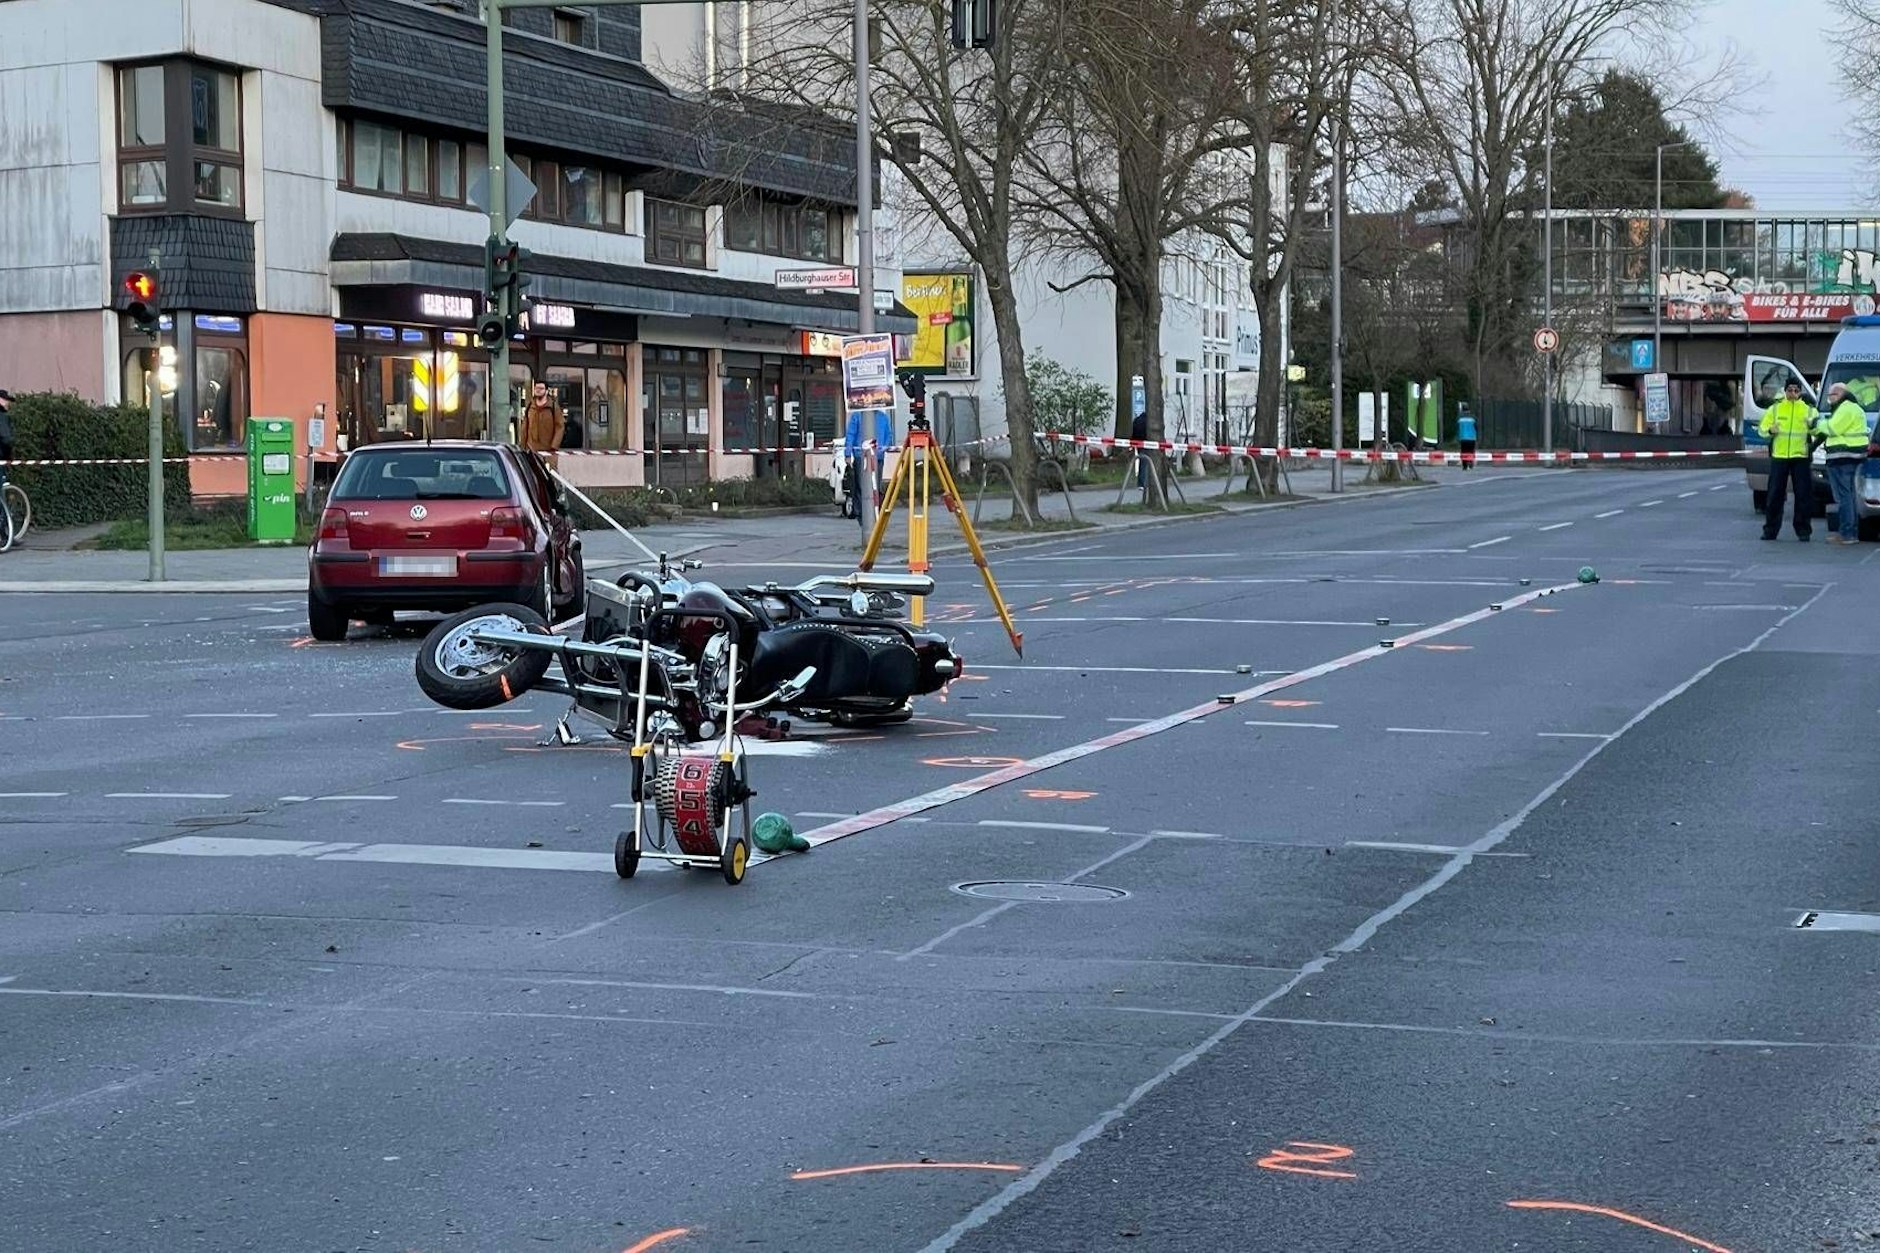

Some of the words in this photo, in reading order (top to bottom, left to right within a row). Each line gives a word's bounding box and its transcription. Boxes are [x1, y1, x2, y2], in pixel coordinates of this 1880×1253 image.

[779, 271, 837, 285] Hildburghauser
[1751, 295, 1787, 306] BIKES
[1788, 296, 1799, 306] &
[1802, 295, 1850, 306] E-BIKES
[1773, 306, 1798, 318] FÜR
[1800, 307, 1829, 318] ALLE
[272, 492, 290, 504] pin
[682, 763, 704, 781] 6
[680, 790, 702, 811] 5
[683, 819, 705, 836] 4
